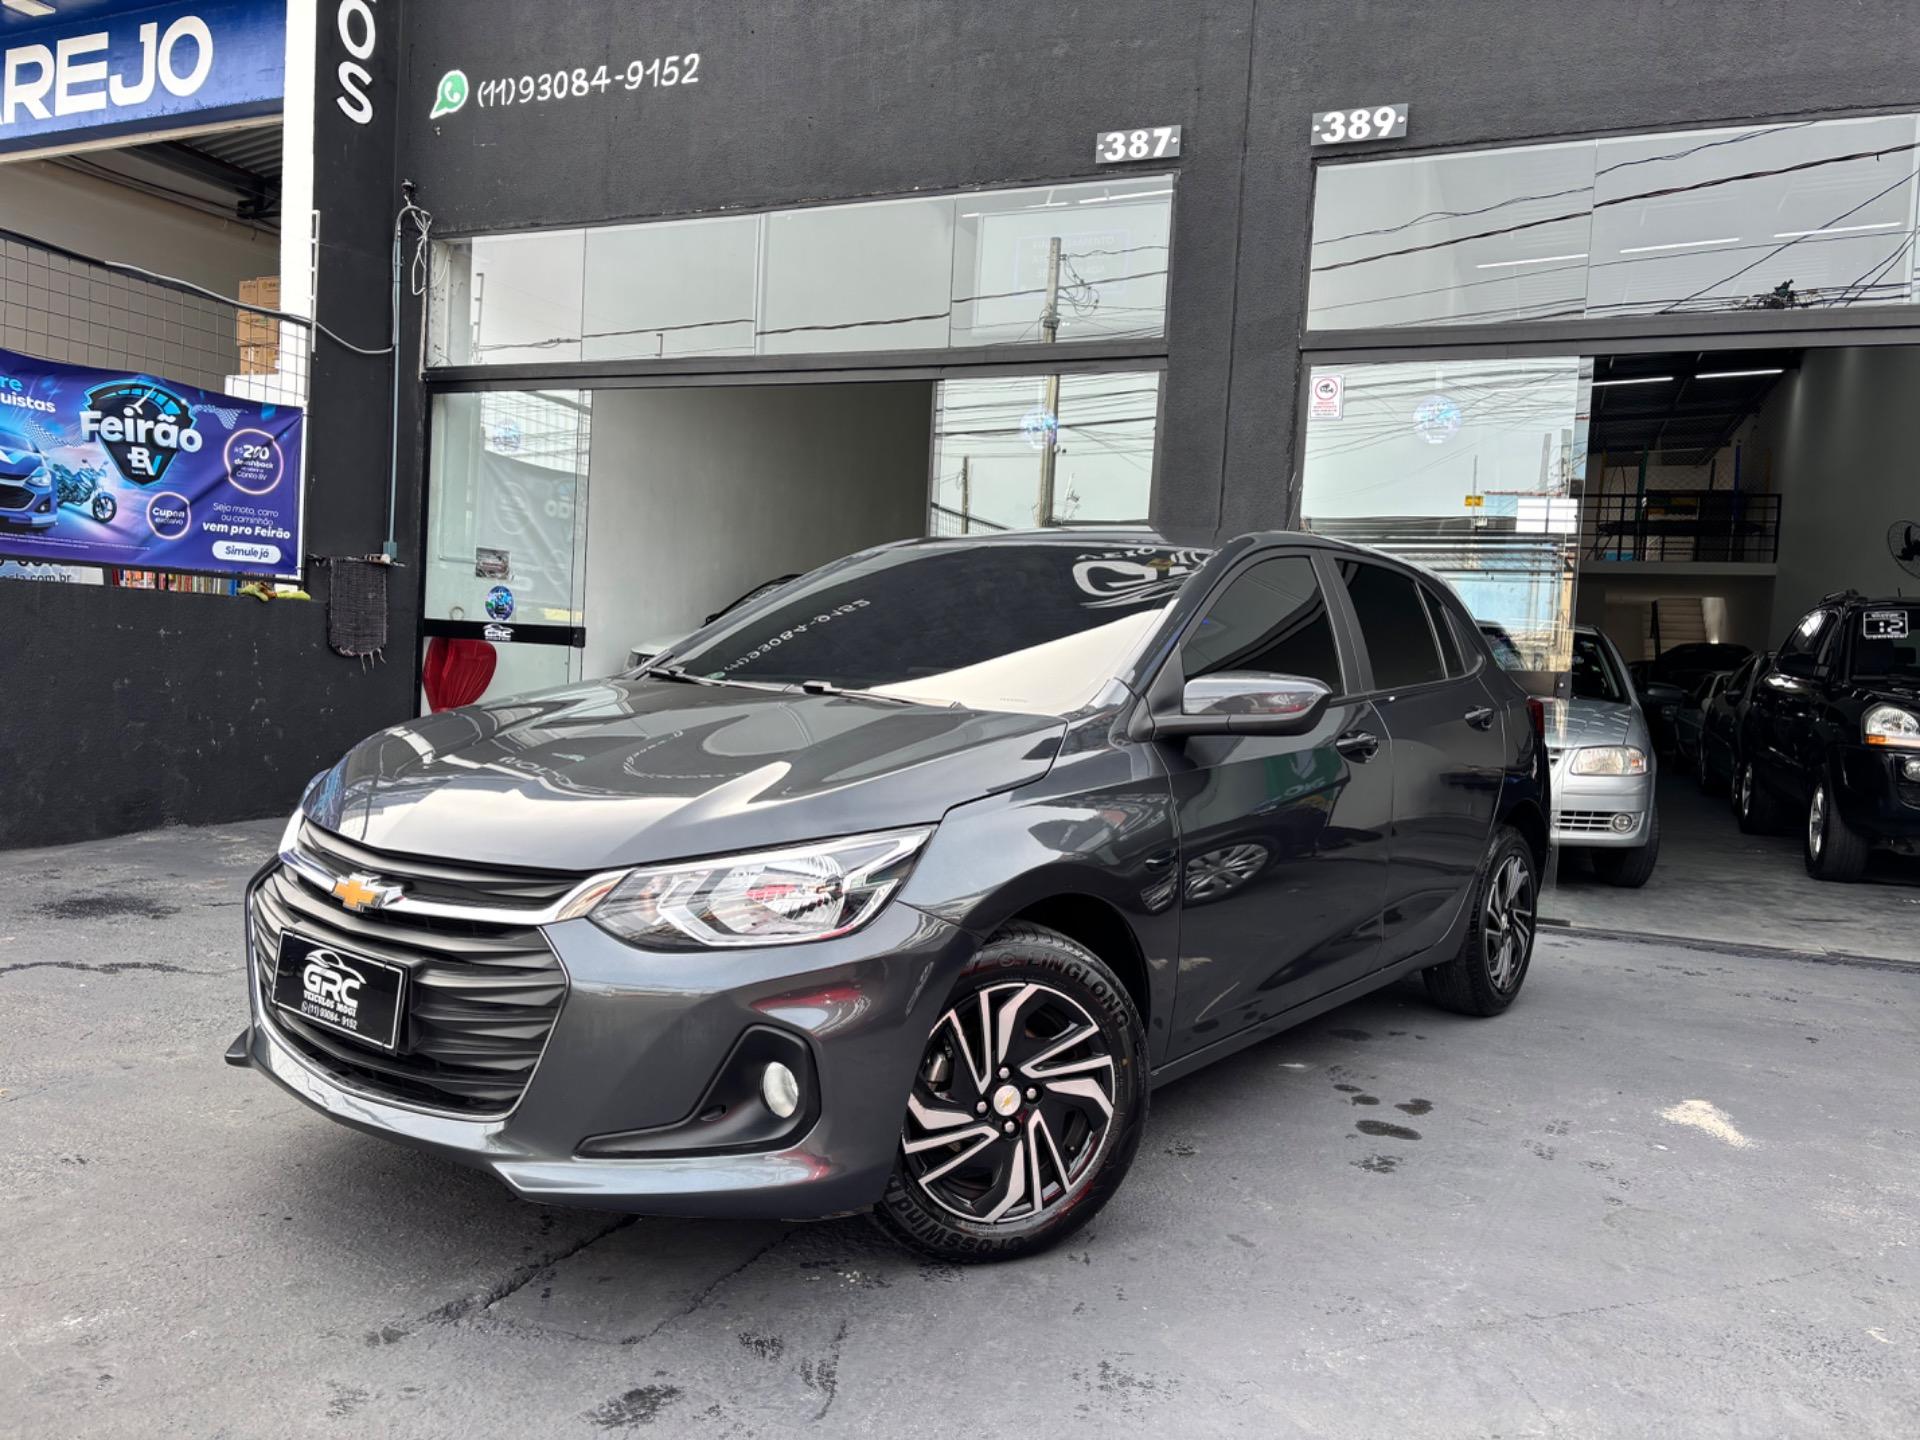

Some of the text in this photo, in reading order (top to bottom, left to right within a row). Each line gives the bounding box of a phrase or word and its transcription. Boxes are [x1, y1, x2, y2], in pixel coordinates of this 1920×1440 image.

[0, 15, 214, 125] REJO
[337, 0, 376, 125] OS
[477, 53, 700, 108] (11)93084-9152
[1321, 106, 1396, 143] 389
[1104, 127, 1172, 161] 387
[79, 406, 203, 453] Feirão
[213, 502, 231, 513] Seja
[257, 508, 279, 518] carro
[221, 514, 232, 522] ou
[202, 521, 292, 540] vem pro Feirão
[225, 545, 258, 558] Simule
[303, 963, 361, 1008] GRC
